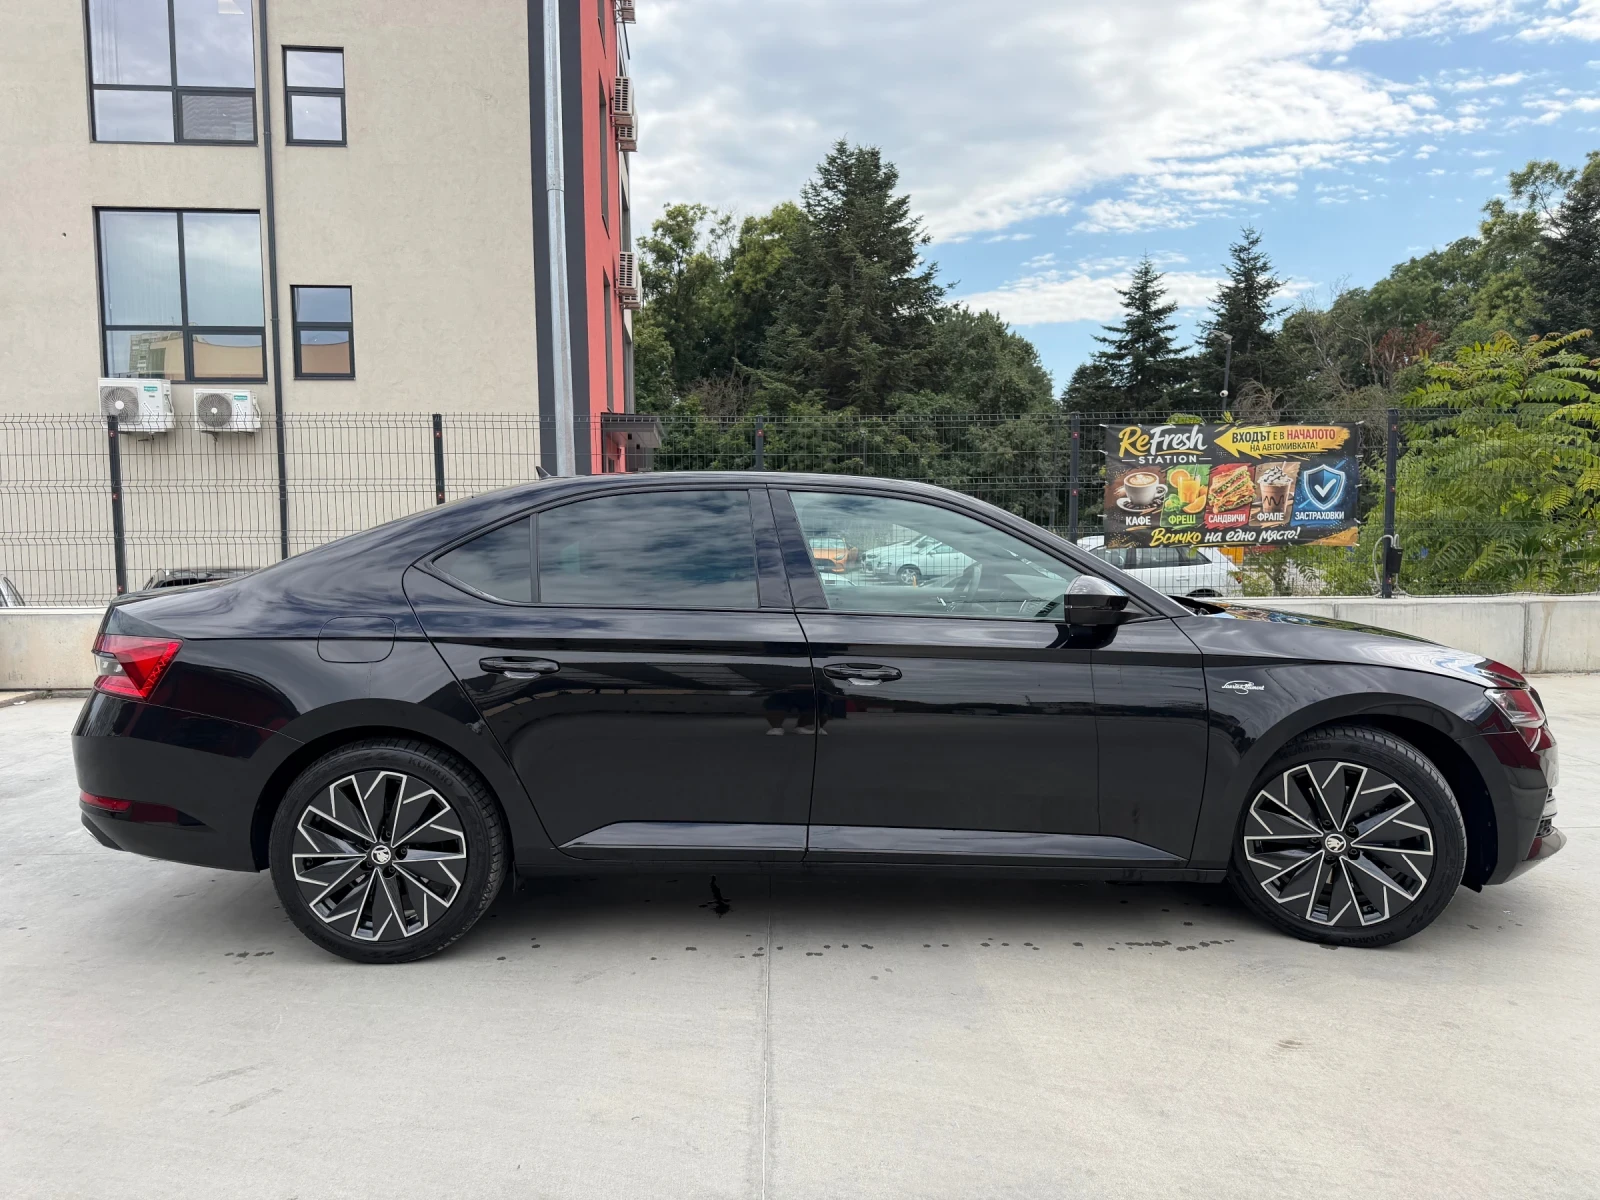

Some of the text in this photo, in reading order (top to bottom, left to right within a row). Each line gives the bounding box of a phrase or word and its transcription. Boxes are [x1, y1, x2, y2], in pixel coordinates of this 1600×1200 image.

[1118, 424, 1208, 457] ReFresh
[1231, 428, 1336, 444] ВХОДЪТ Е В НАЧАЛОТО
[1250, 441, 1318, 453] НА АВТОМИВКАТА!
[1138, 455, 1197, 465] STATION
[1125, 515, 1152, 526] КАФЕ
[1168, 514, 1196, 525] ФРЕШ
[1208, 513, 1246, 524] САНДВИЧИ
[1256, 512, 1285, 521] ФРАПЕ
[1294, 511, 1345, 521] ЗАСТРАХОВКИ
[1149, 526, 1301, 547] Всичко на едно място!
[1340, 931, 1396, 944] KUMHO
